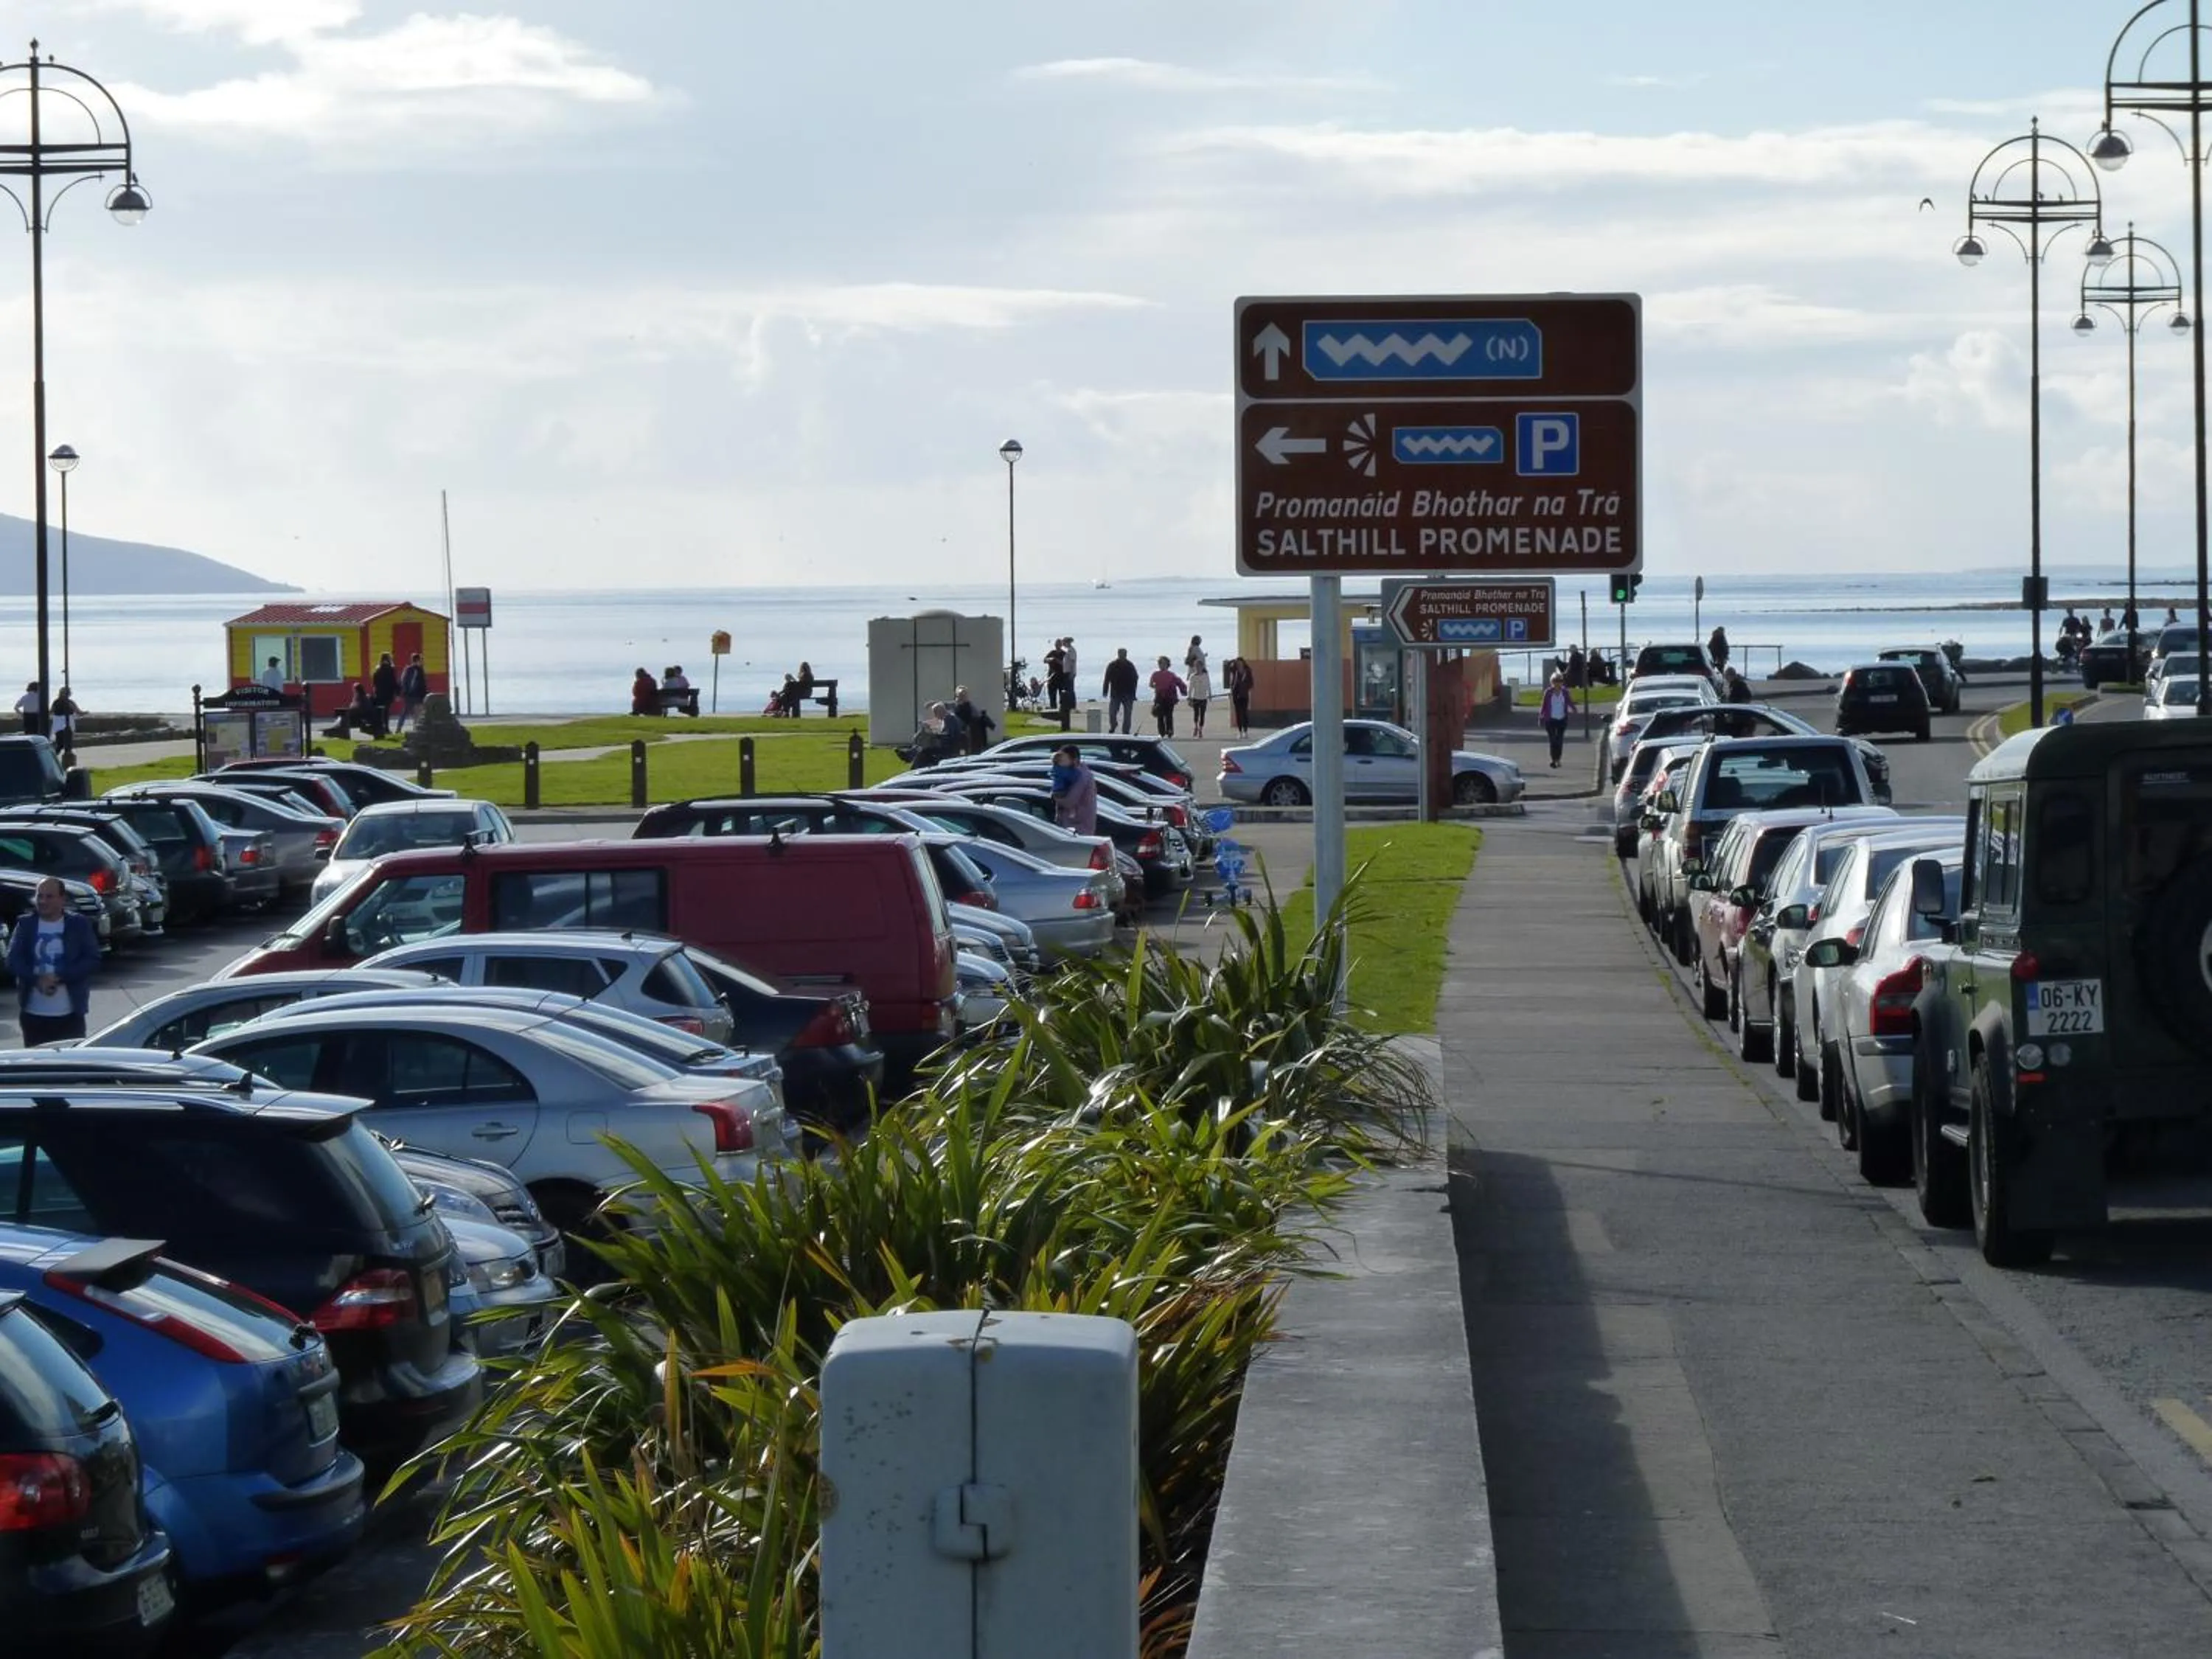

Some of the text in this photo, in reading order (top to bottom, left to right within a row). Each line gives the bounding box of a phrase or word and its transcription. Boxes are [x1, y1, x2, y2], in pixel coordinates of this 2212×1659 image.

[1485, 335, 1528, 361] (N)
[1531, 420, 1570, 470] P
[1255, 489, 1620, 518] Promanáid Bhothar na Trá
[1256, 526, 1622, 556] SALTHILL PROMENADE
[1419, 602, 1545, 614] SALTHILL PROMENADE
[1511, 620, 1524, 638] P
[2040, 984, 2098, 1009] 06-KY
[2047, 1010, 2093, 1032] 2222
